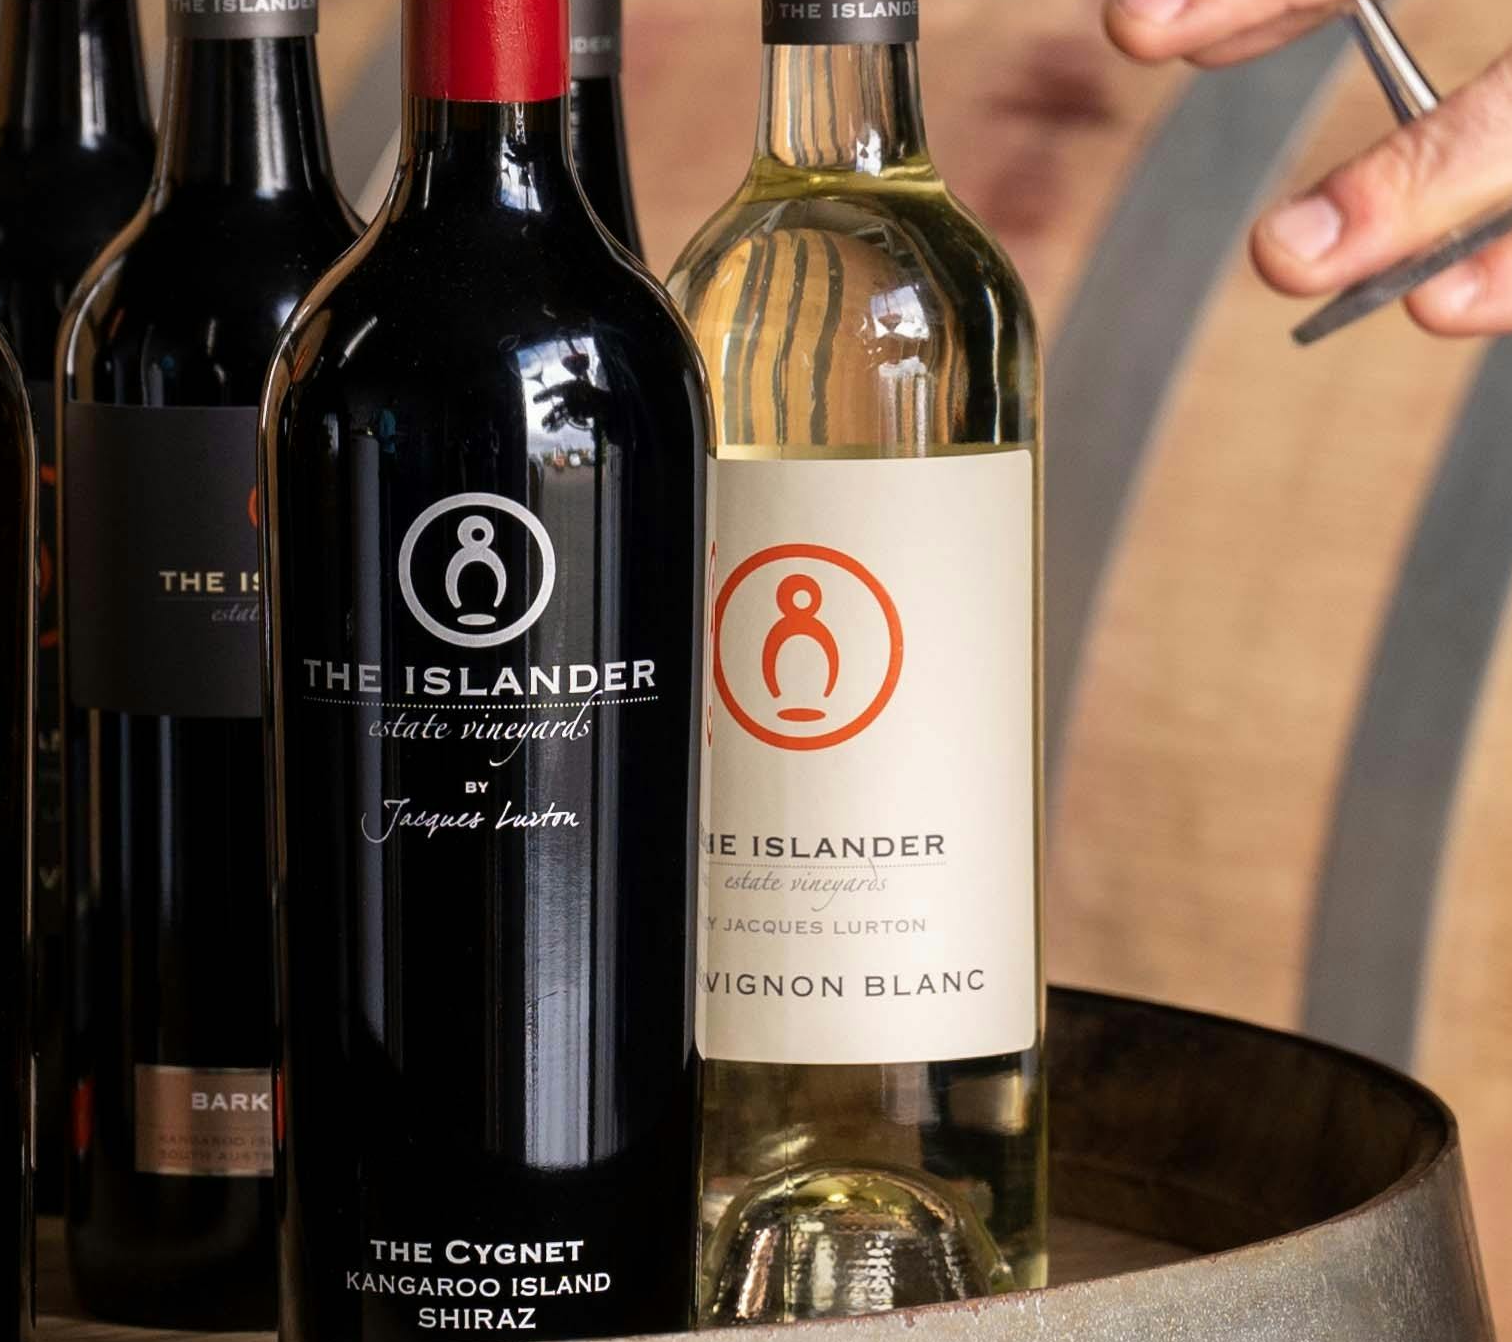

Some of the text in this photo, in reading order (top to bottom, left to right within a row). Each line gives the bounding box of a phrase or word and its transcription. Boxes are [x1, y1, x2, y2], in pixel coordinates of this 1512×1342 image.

[778, 2, 821, 19] THE
[159, 571, 225, 593] THE
[303, 658, 656, 697] THE ISLANDER
[368, 689, 604, 767] estate vineyards
[465, 781, 489, 794] BY
[361, 798, 580, 844] Jacques Lurton
[752, 833, 945, 858] ISLANDER
[724, 857, 888, 912] estate vineyards
[723, 918, 824, 935] JACQUES
[833, 918, 926, 935] LURTON
[865, 969, 985, 997] BLANC
[191, 1092, 269, 1111] BARK
[370, 1239, 432, 1264] THE
[346, 1270, 611, 1297] KANGAROO ISLAND
[418, 1307, 537, 1330] SHIRAZ
